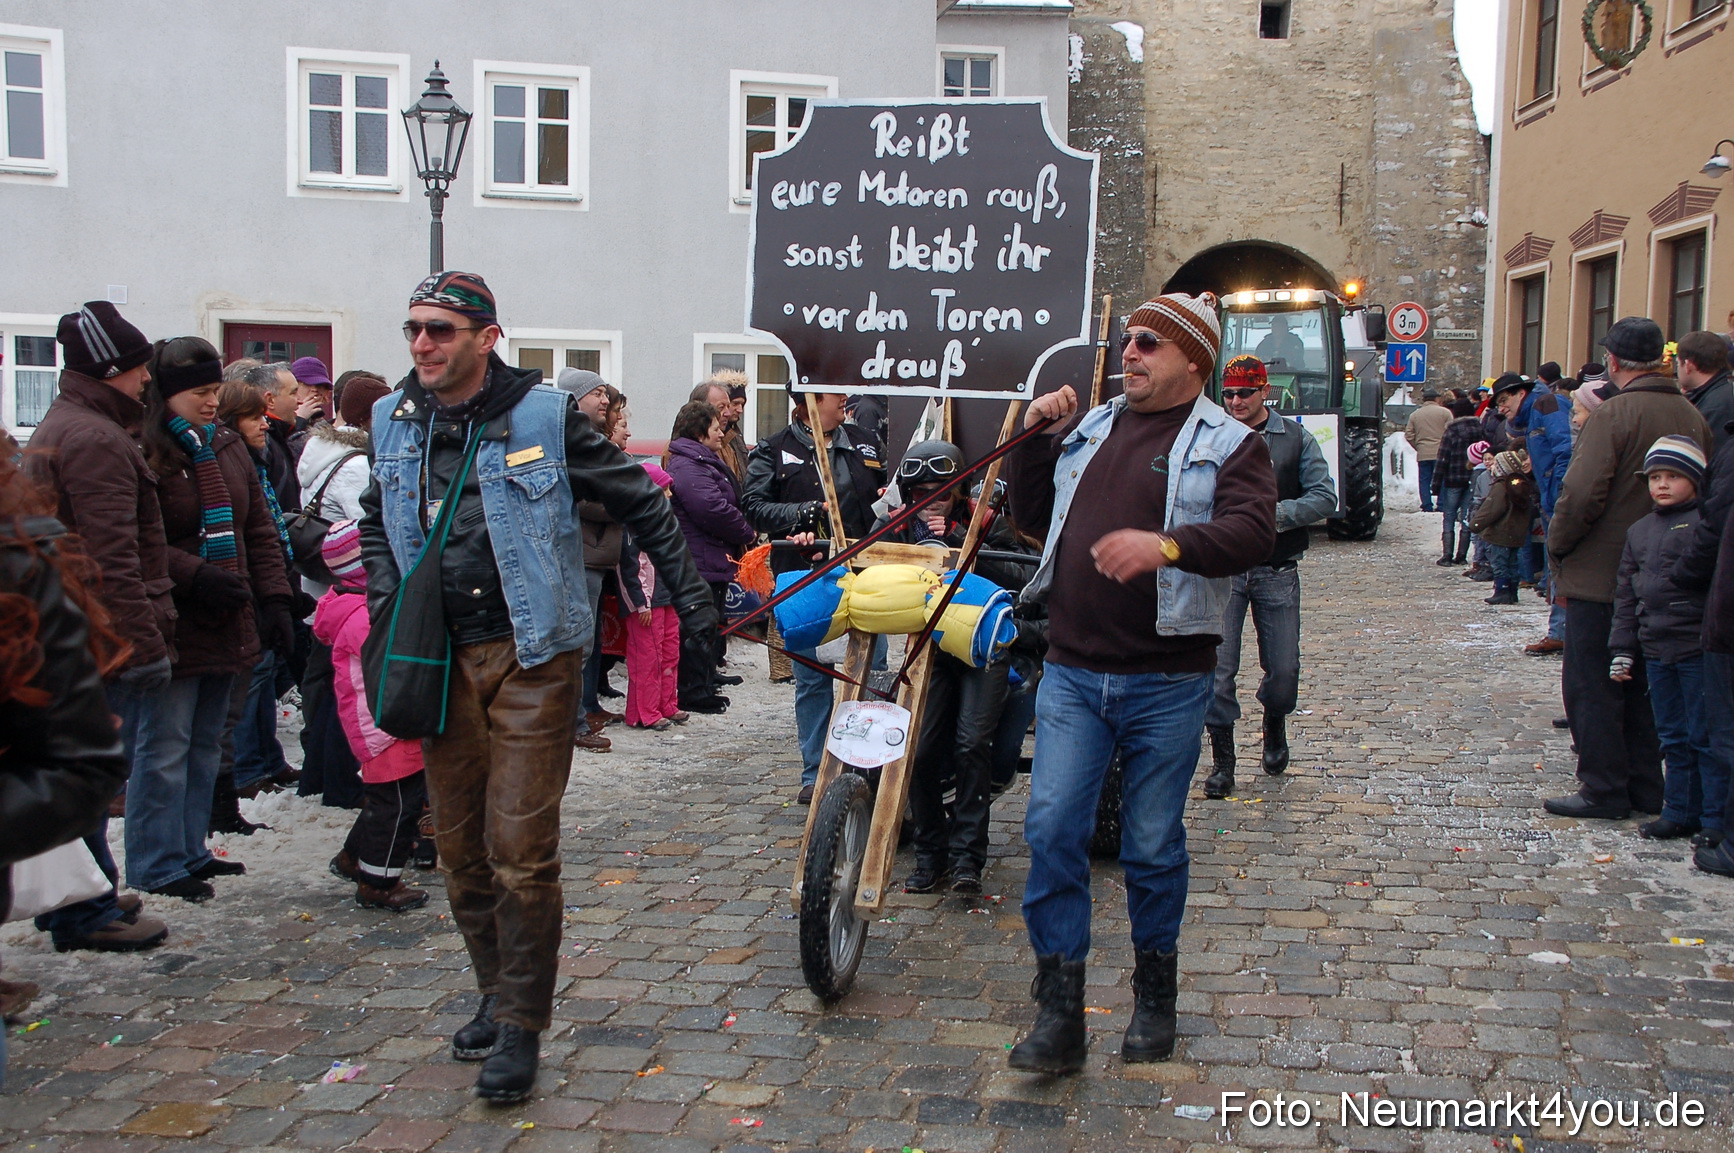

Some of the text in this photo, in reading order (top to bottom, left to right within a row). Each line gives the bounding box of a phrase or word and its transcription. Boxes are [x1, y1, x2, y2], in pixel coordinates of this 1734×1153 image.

[869, 111, 971, 164] Reißt
[771, 163, 1067, 223] eure Motoren rauß,
[783, 222, 1052, 273] sonst bleibt ihr
[803, 289, 1022, 332] vor den Toren
[1399, 314, 1417, 329] 3 m
